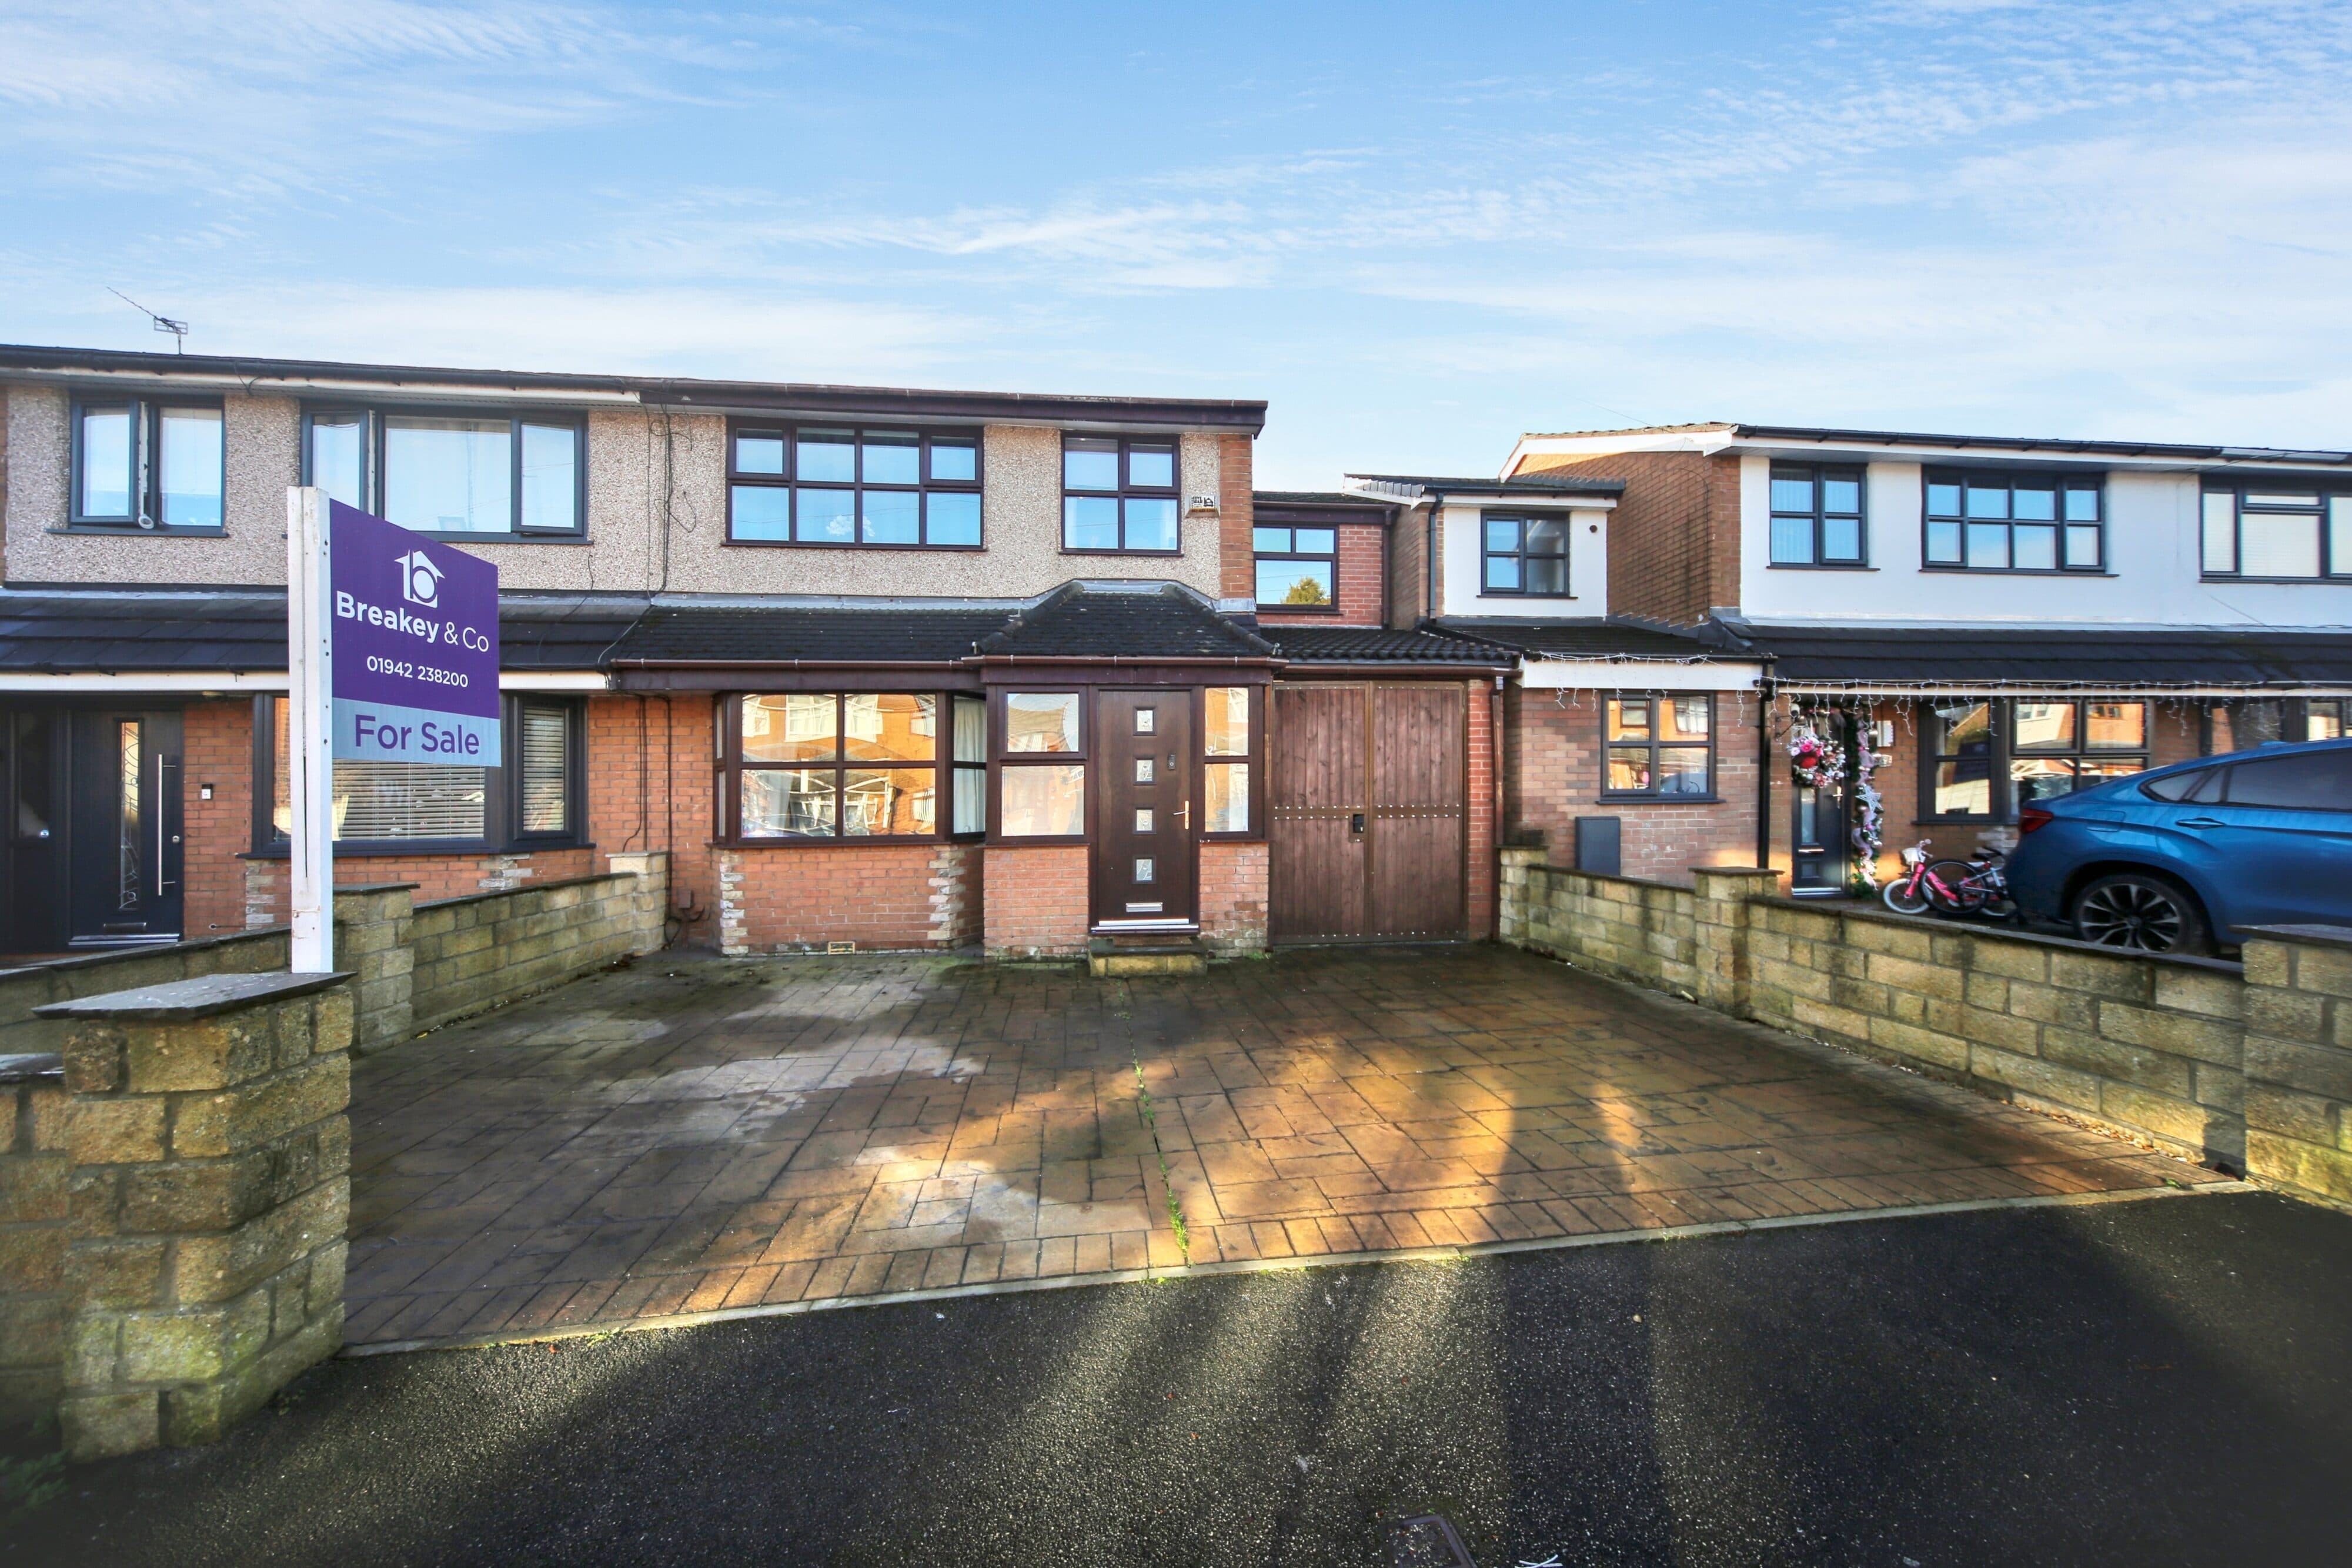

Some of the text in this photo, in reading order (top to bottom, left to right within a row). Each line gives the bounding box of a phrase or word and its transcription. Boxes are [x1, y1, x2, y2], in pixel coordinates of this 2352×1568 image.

[336, 590, 489, 653] Breakey & Co
[366, 656, 469, 688] 01942 238200
[355, 714, 480, 755] For Sale
